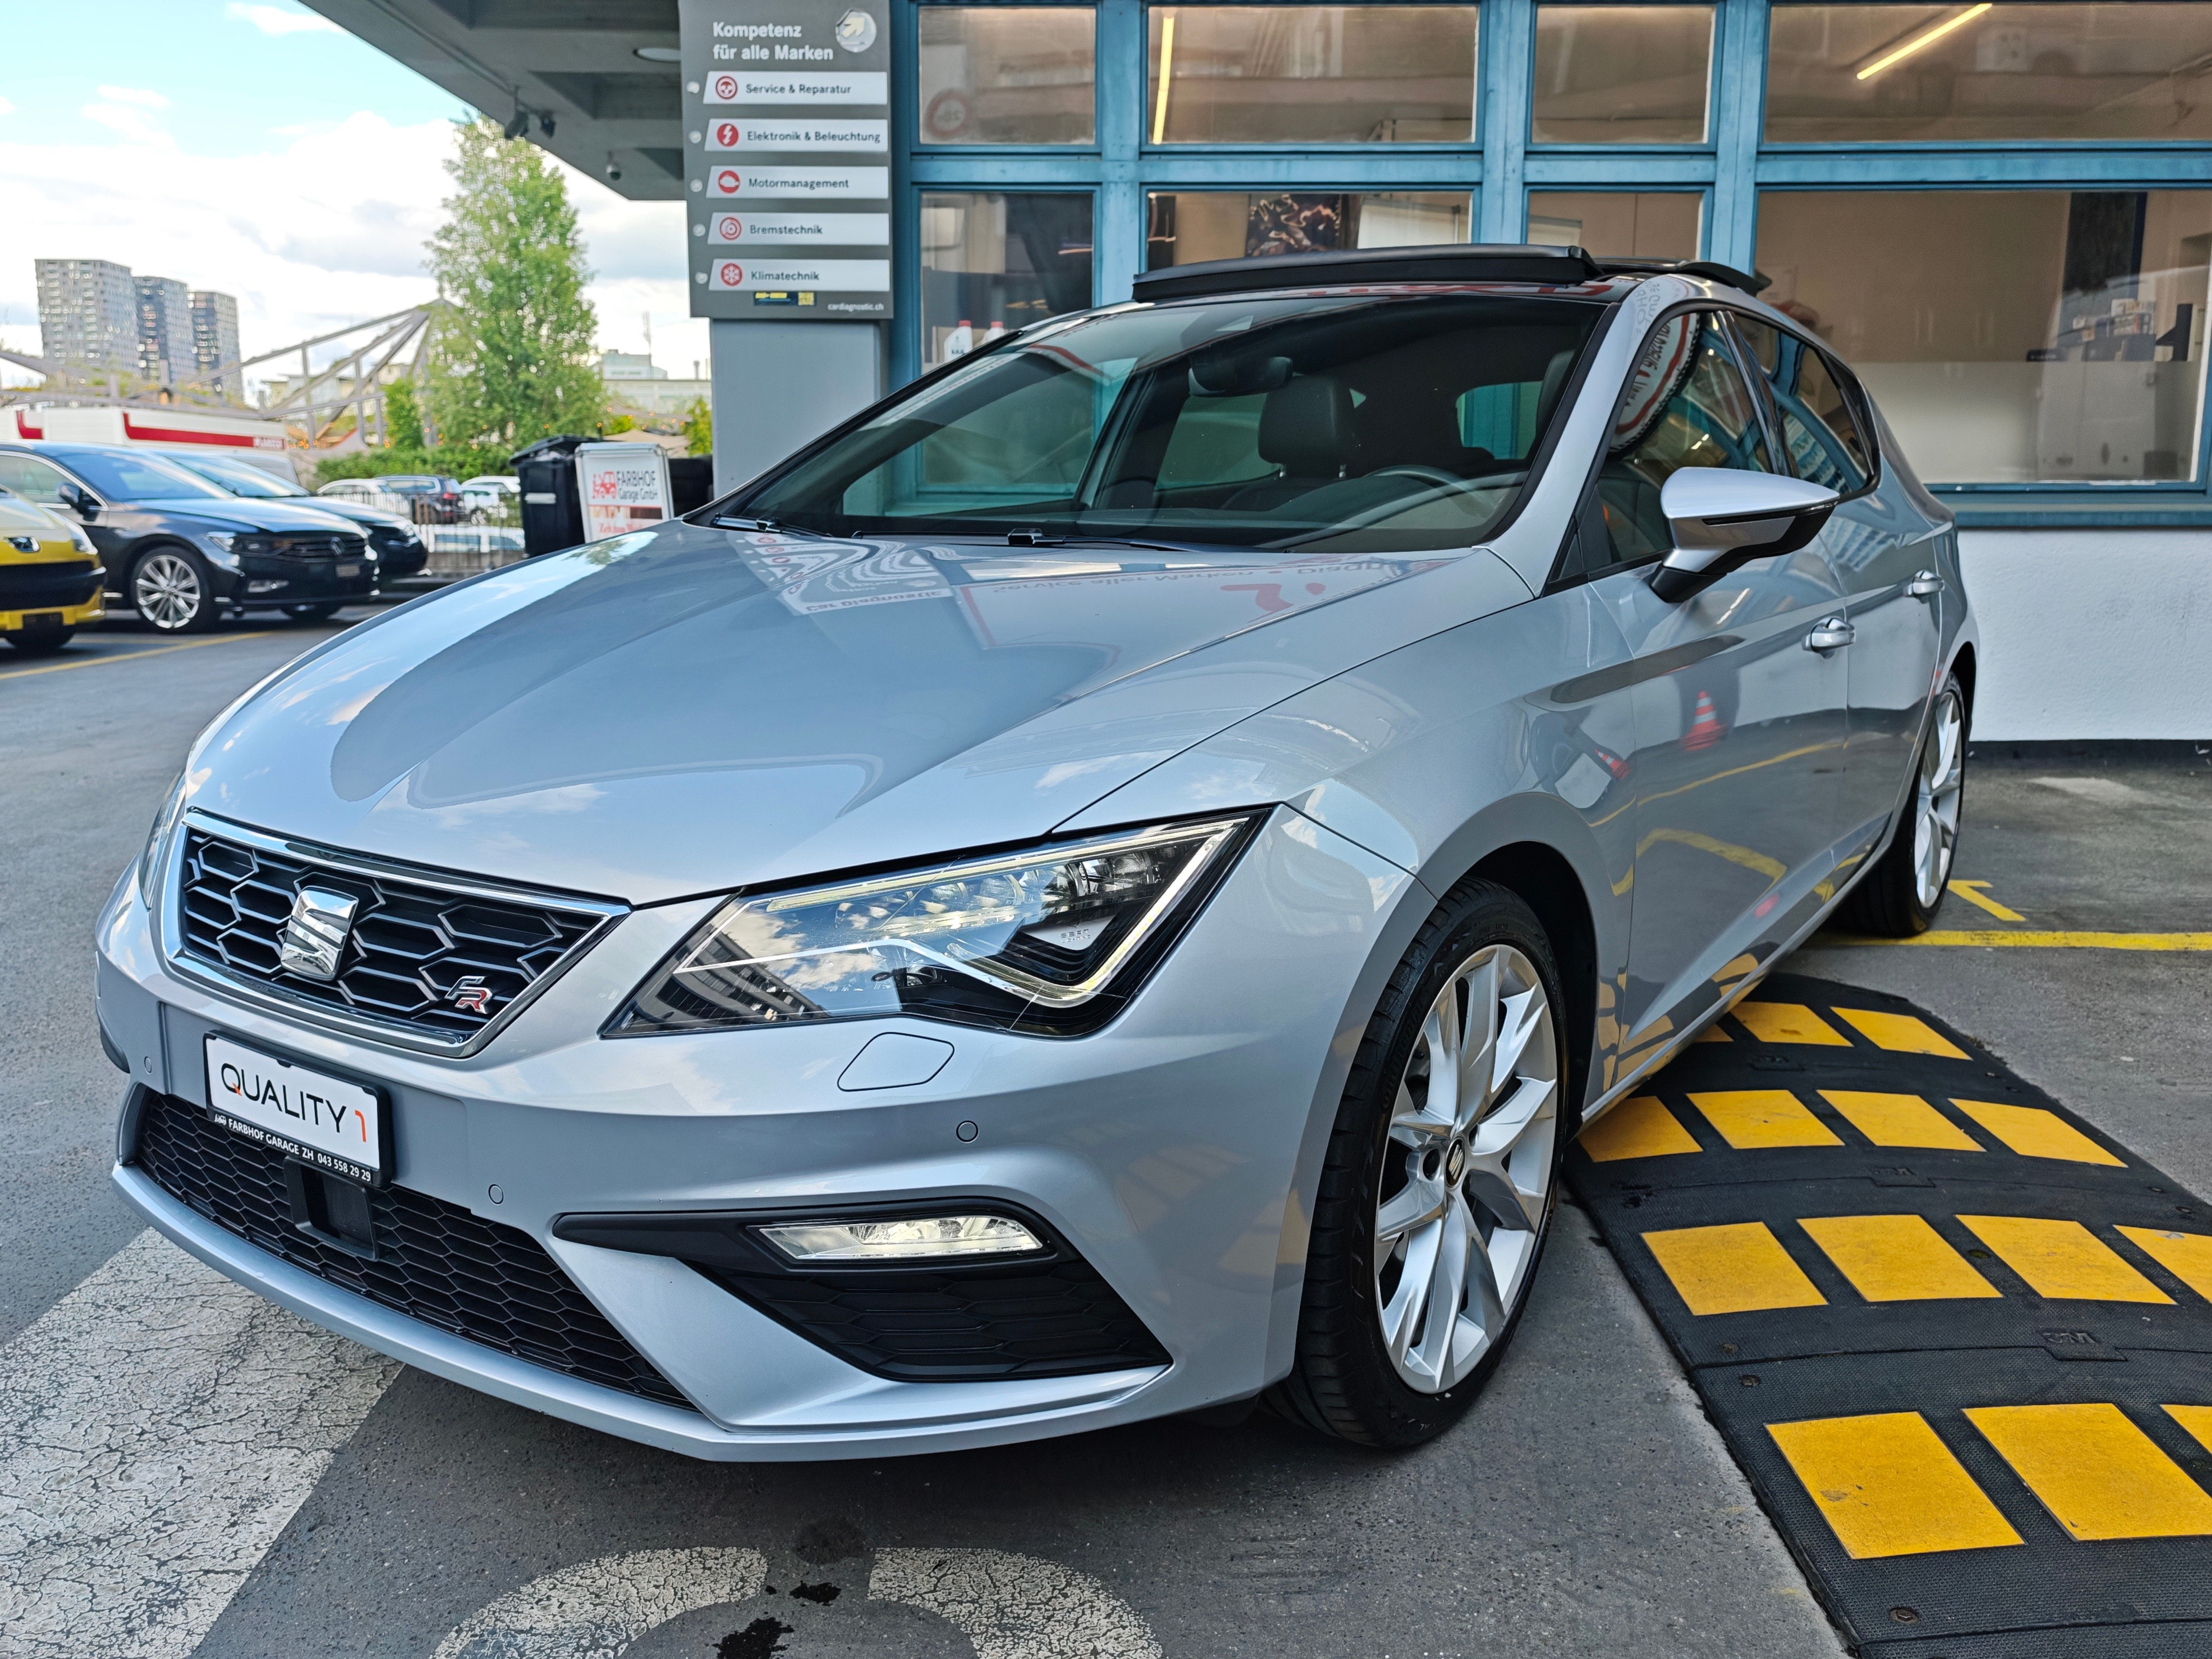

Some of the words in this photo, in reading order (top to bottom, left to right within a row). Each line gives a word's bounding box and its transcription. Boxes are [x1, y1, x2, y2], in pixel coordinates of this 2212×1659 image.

[712, 22, 802, 41] Kompetenz
[712, 44, 737, 60] für
[741, 44, 770, 60] alle
[774, 44, 834, 60] Marken
[745, 84, 786, 94] Service
[789, 84, 795, 94] &
[799, 84, 851, 96] Reparatur
[747, 131, 801, 141] Elektronik
[804, 131, 811, 141] &
[815, 131, 880, 143] Beleuchtung
[748, 178, 849, 191] Motormanagement
[750, 225, 823, 235] Bremstechnik
[751, 271, 820, 281] Klimatechnik
[617, 470, 656, 486] FARBHOF
[618, 489, 639, 503] Garage
[641, 488, 658, 500] GmbH
[444, 975, 493, 1014] FR
[221, 1063, 347, 1133] QUALITY
[228, 1119, 264, 1141] FARBHOF
[266, 1134, 299, 1155] GARAGE
[302, 1147, 314, 1161] ZH
[318, 1153, 332, 1167] 043
[334, 1158, 348, 1173] 558
[350, 1165, 359, 1177] 29
[361, 1169, 371, 1182] 29
